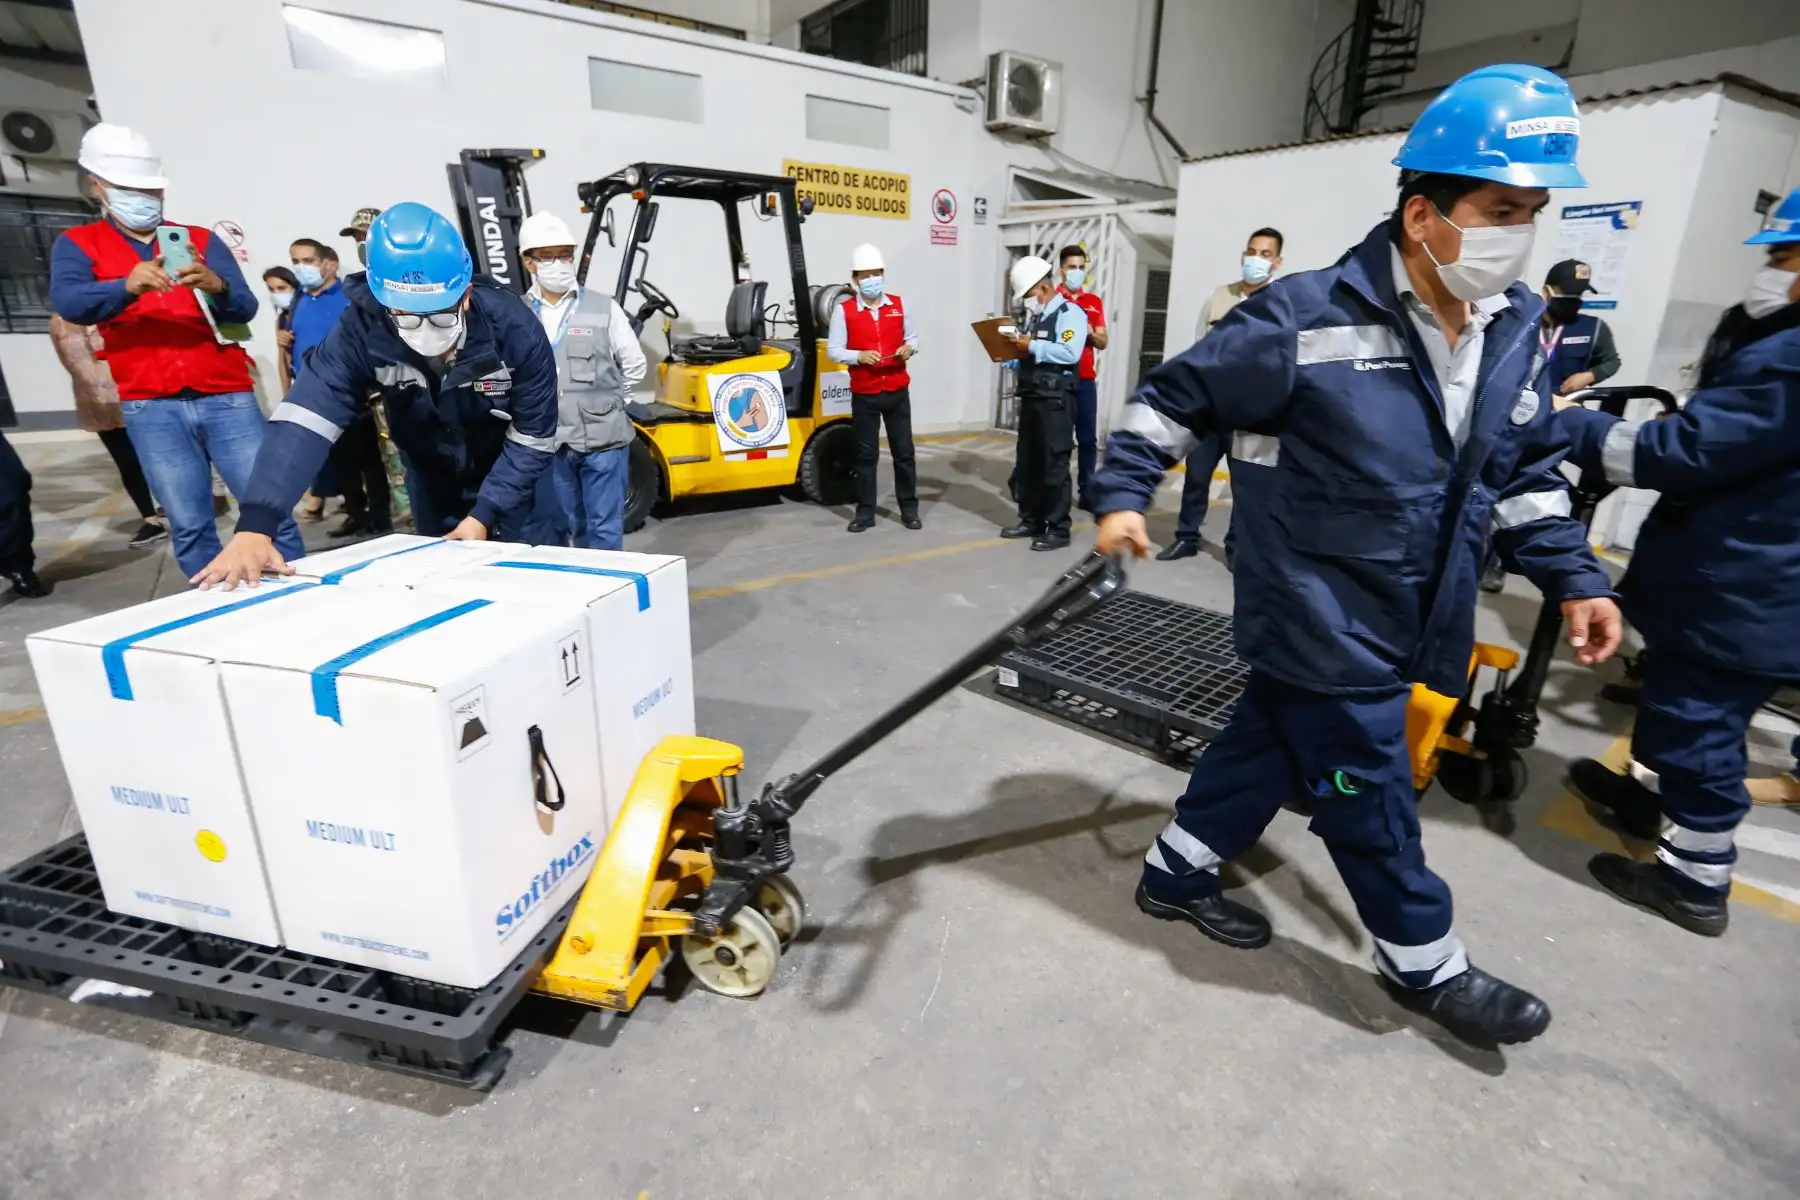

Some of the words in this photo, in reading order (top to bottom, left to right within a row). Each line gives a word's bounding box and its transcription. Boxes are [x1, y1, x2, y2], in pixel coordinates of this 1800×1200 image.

[787, 165, 840, 186] CENTRO
[843, 171, 860, 188] DE
[863, 174, 907, 193] ACOPIO
[797, 189, 852, 209] ESIDUOS
[856, 194, 906, 214] SOLIDOS
[476, 196, 511, 285] YUNDAI
[632, 688, 661, 720] MEDIUM
[662, 677, 673, 698] ULT
[110, 785, 165, 812] MEDIUM
[165, 794, 190, 815] ULT
[305, 819, 367, 848] MEDIUM
[369, 829, 396, 852] ULT
[496, 836, 594, 937] Softbox
